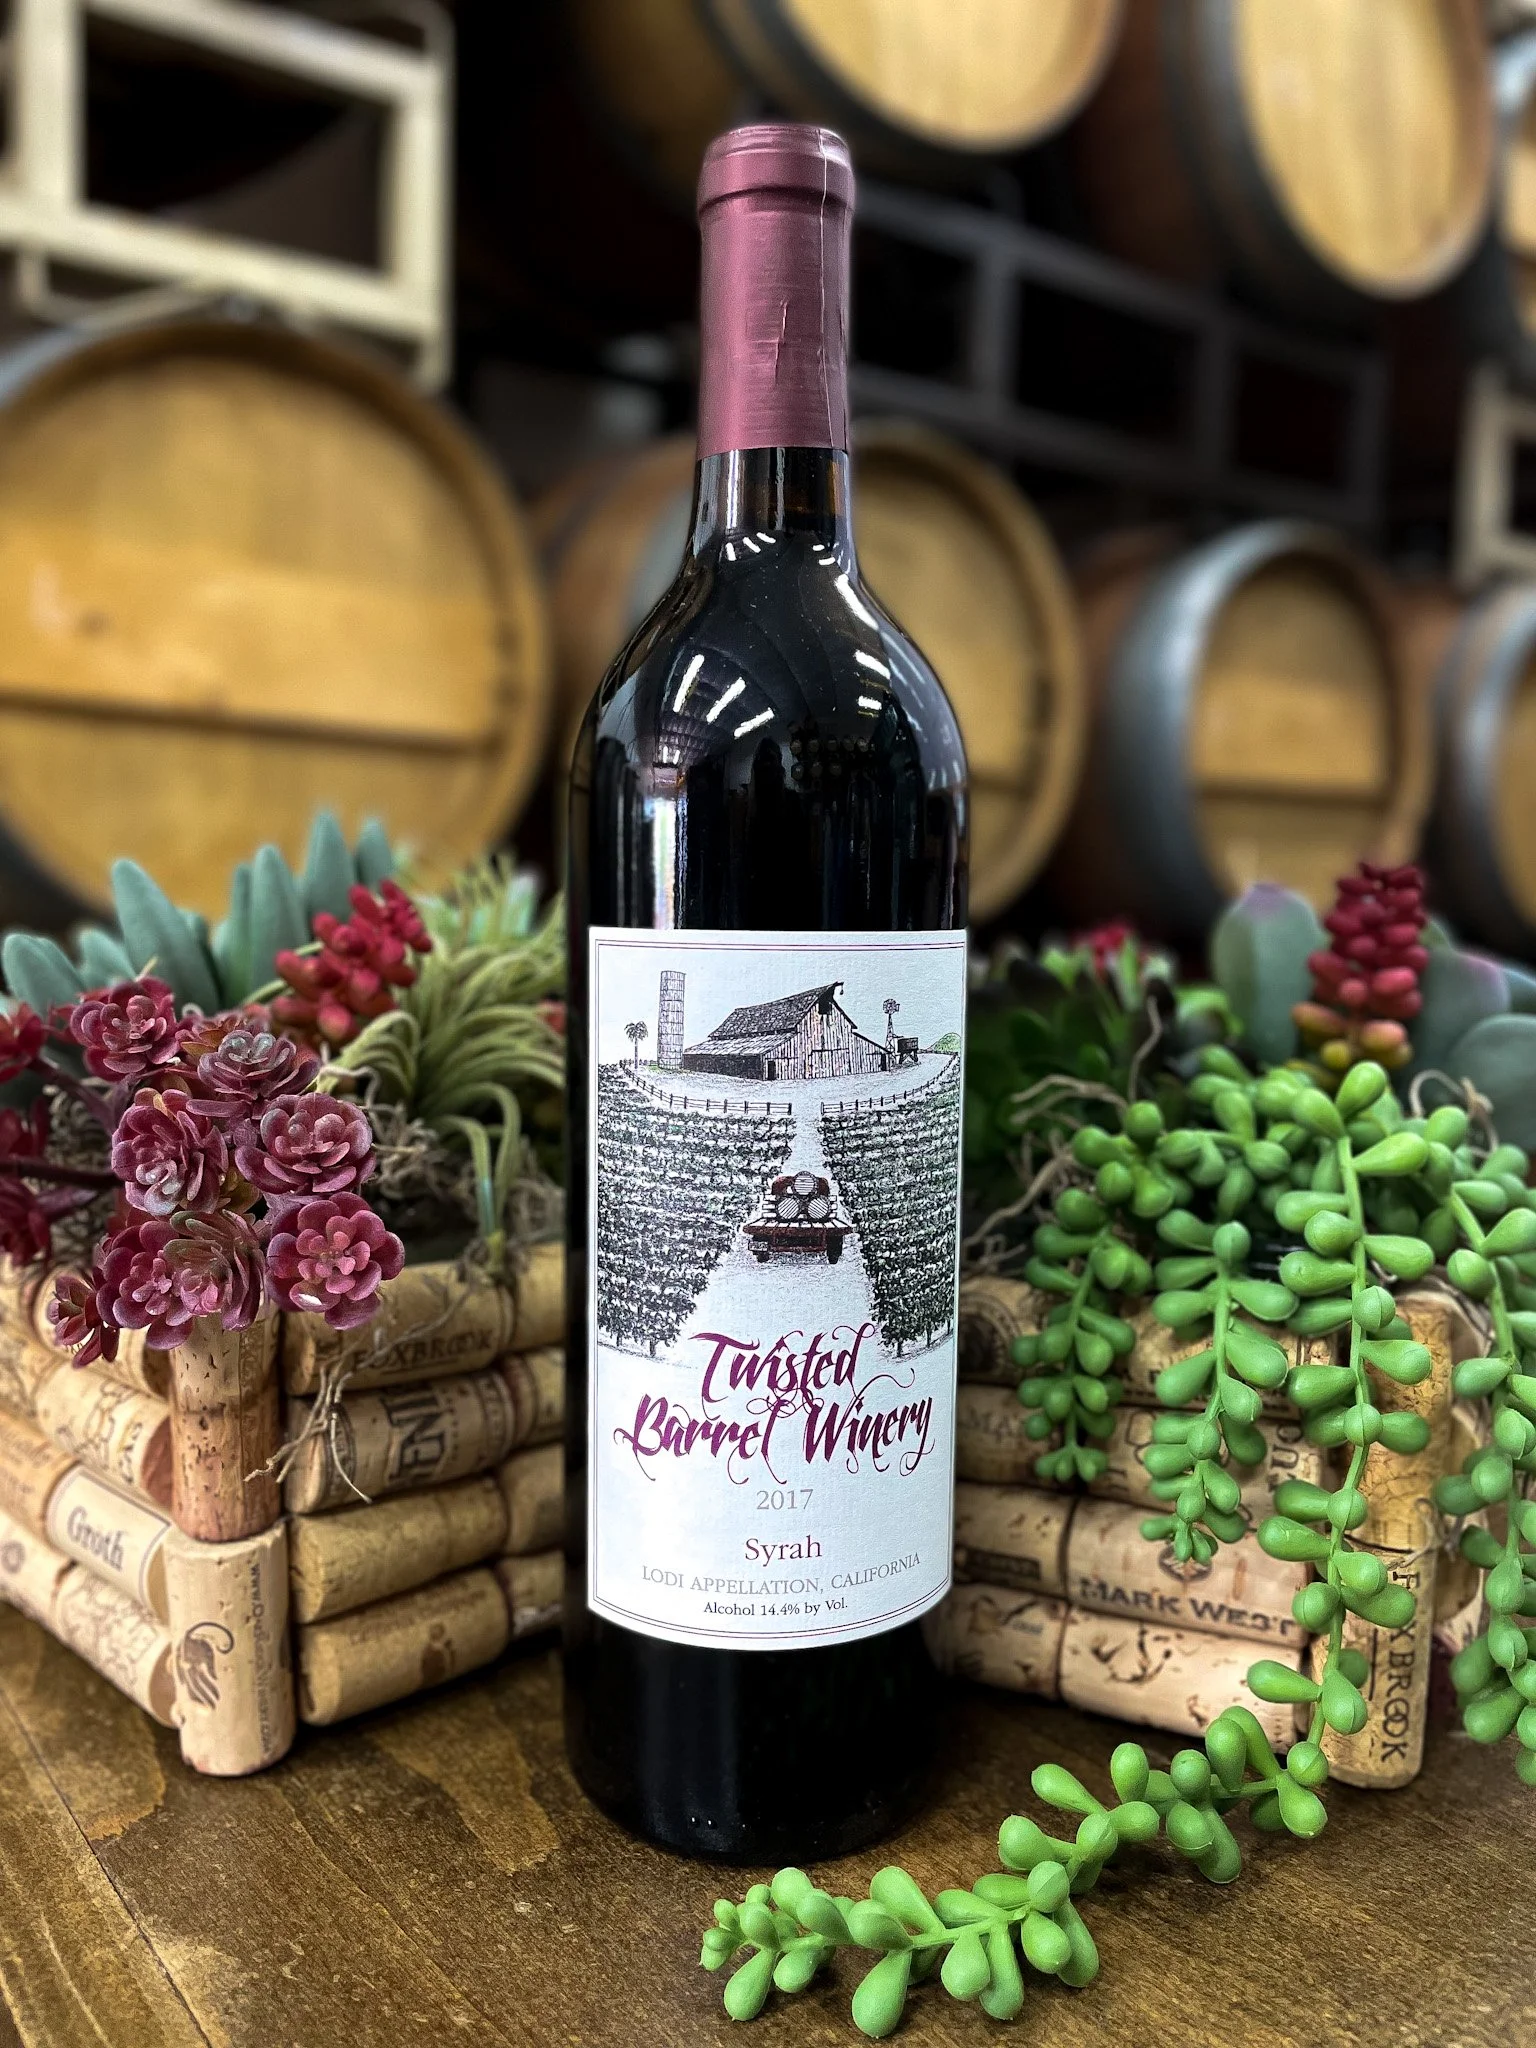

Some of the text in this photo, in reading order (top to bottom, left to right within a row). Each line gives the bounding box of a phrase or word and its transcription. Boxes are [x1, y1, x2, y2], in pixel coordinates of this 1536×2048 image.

[689, 1322, 876, 1408] Twisted
[614, 1394, 790, 1484] Barrel
[802, 1390, 935, 1477] Winery
[756, 1488, 814, 1511] 2017
[67, 1505, 124, 1572] Groth
[744, 1535, 823, 1567] Syrah
[641, 1552, 921, 1595] LODI APPELLATION, CALIFORNIA
[703, 1597, 848, 1617] Alcohol 14.4% by Vol.
[1078, 1576, 1298, 1637] MARK WEST
[1381, 1571, 1421, 1763] FXBROOK
